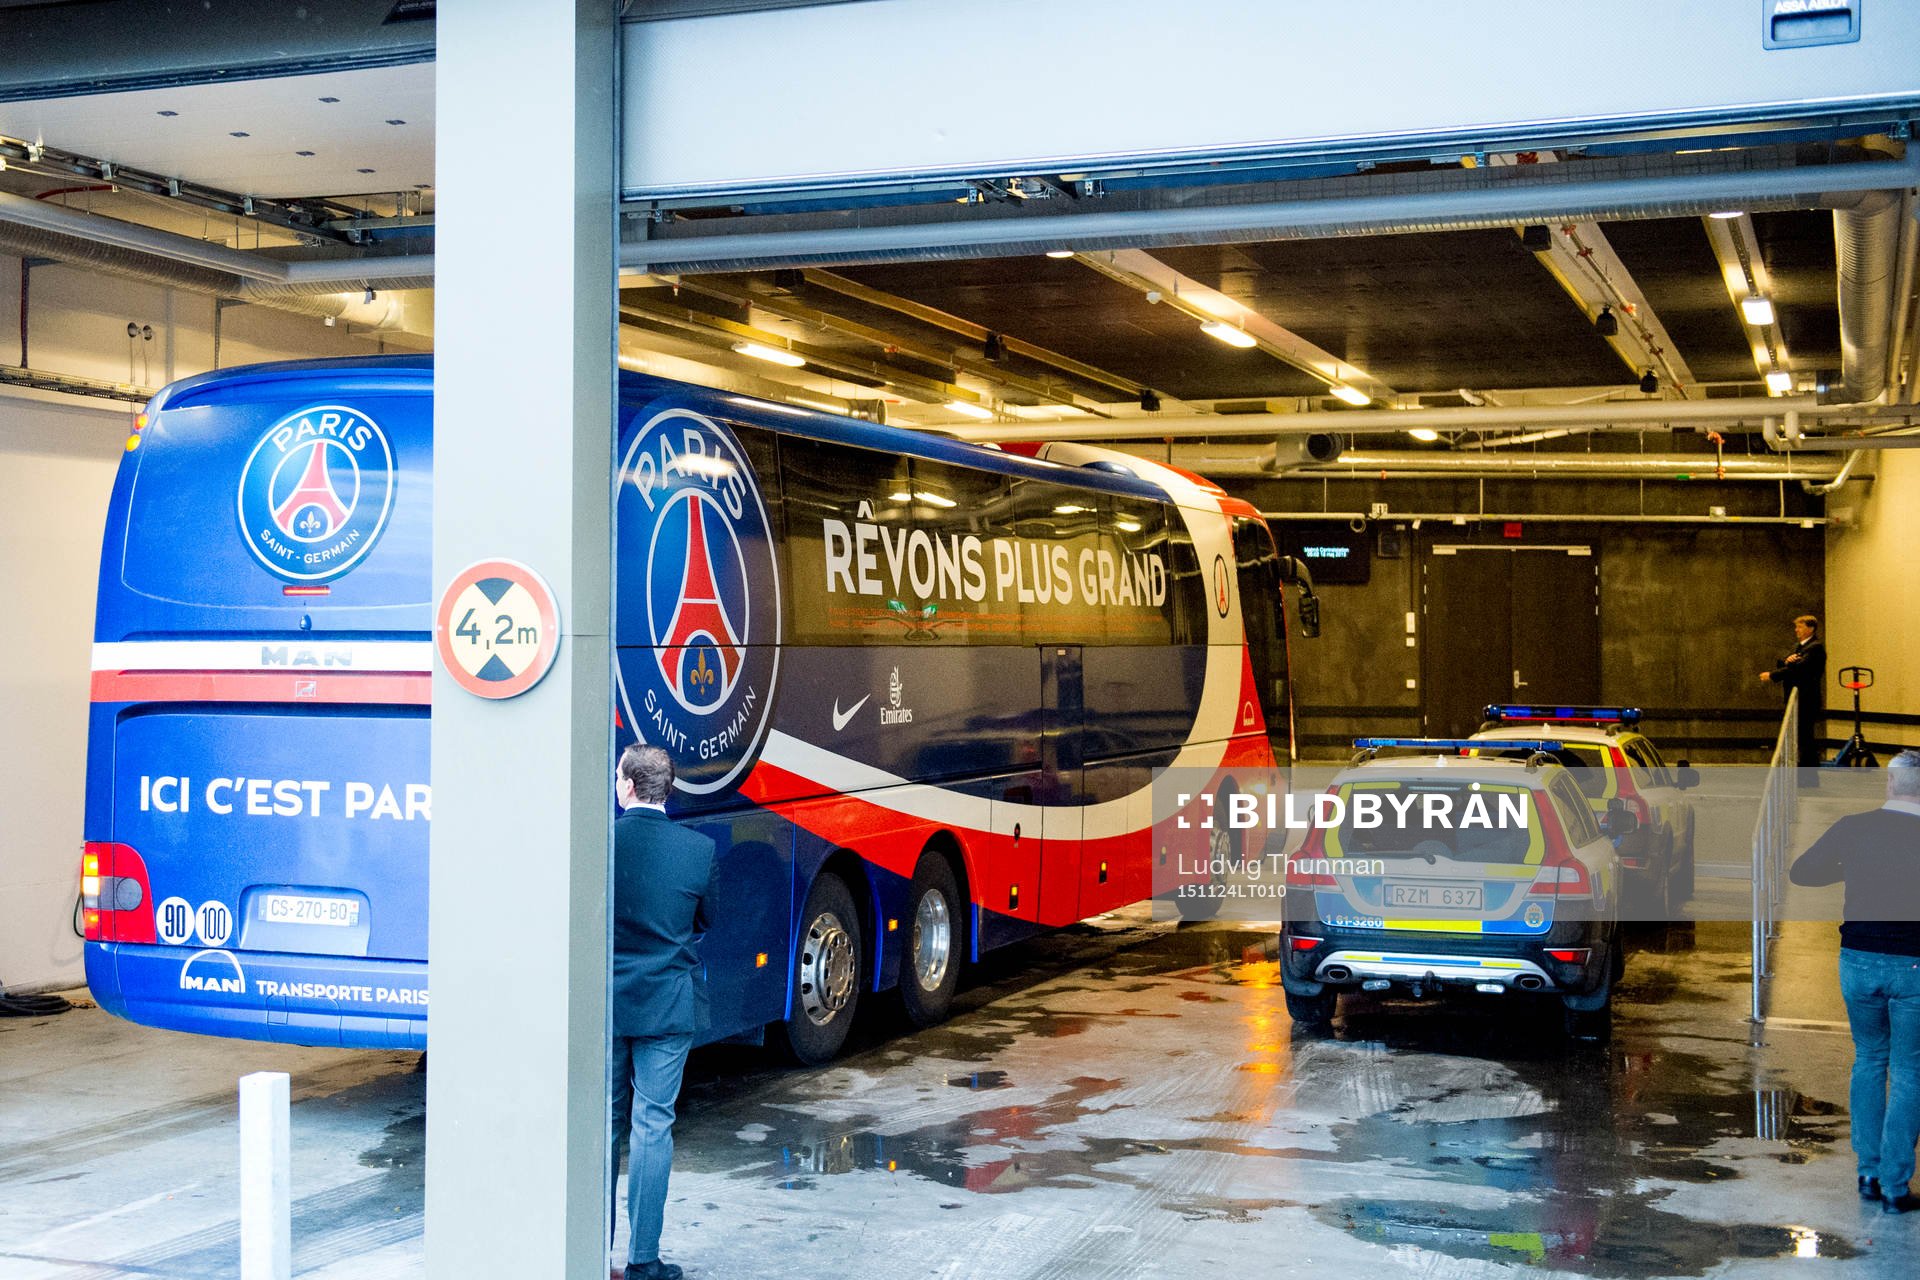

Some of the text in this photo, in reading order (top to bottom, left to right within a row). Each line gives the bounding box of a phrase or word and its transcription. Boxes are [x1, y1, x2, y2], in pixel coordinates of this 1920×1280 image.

[272, 413, 373, 452] PARIS
[632, 428, 746, 520] PARIS
[823, 499, 1166, 607] RÊVONS PLUS GRAND
[261, 646, 352, 666] MAN
[880, 706, 913, 725] Emirates
[140, 775, 190, 812] ICI
[205, 777, 330, 817] C'EST
[1395, 888, 1477, 905] RZM 637
[165, 904, 186, 937] 90
[202, 907, 226, 940] 100
[185, 976, 240, 992] MAN
[256, 980, 430, 1005] TRANSPORTE PARIS
